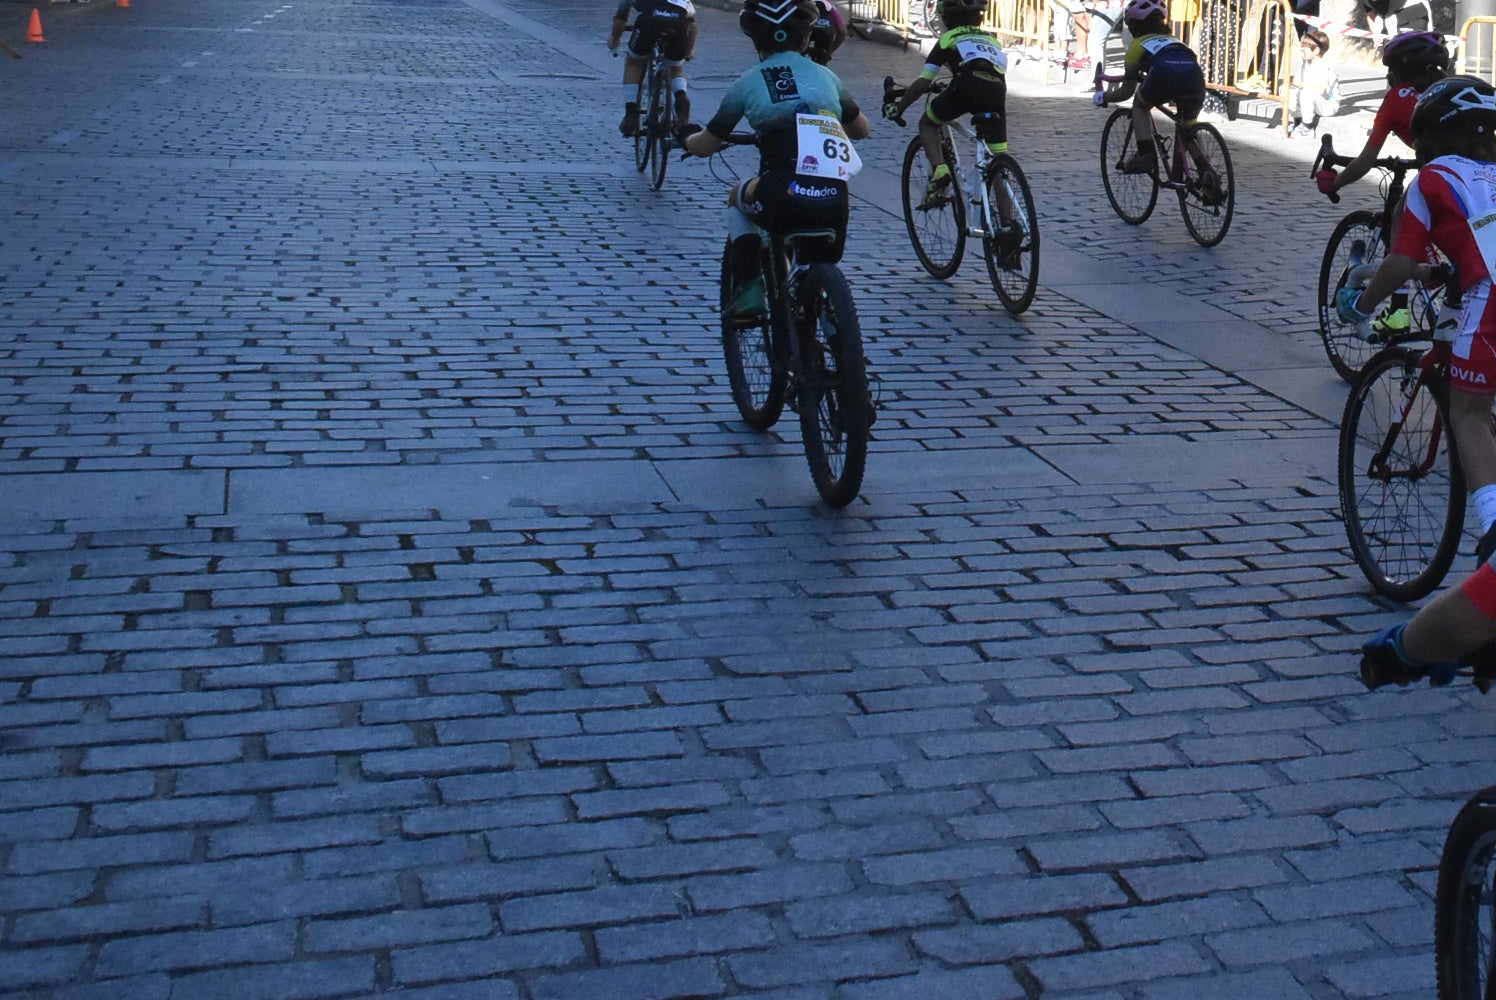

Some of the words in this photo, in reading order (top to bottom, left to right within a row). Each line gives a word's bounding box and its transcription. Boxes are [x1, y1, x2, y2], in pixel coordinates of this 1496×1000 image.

[976, 44, 998, 56] 66
[823, 138, 851, 163] 63
[795, 183, 837, 197] tecindro
